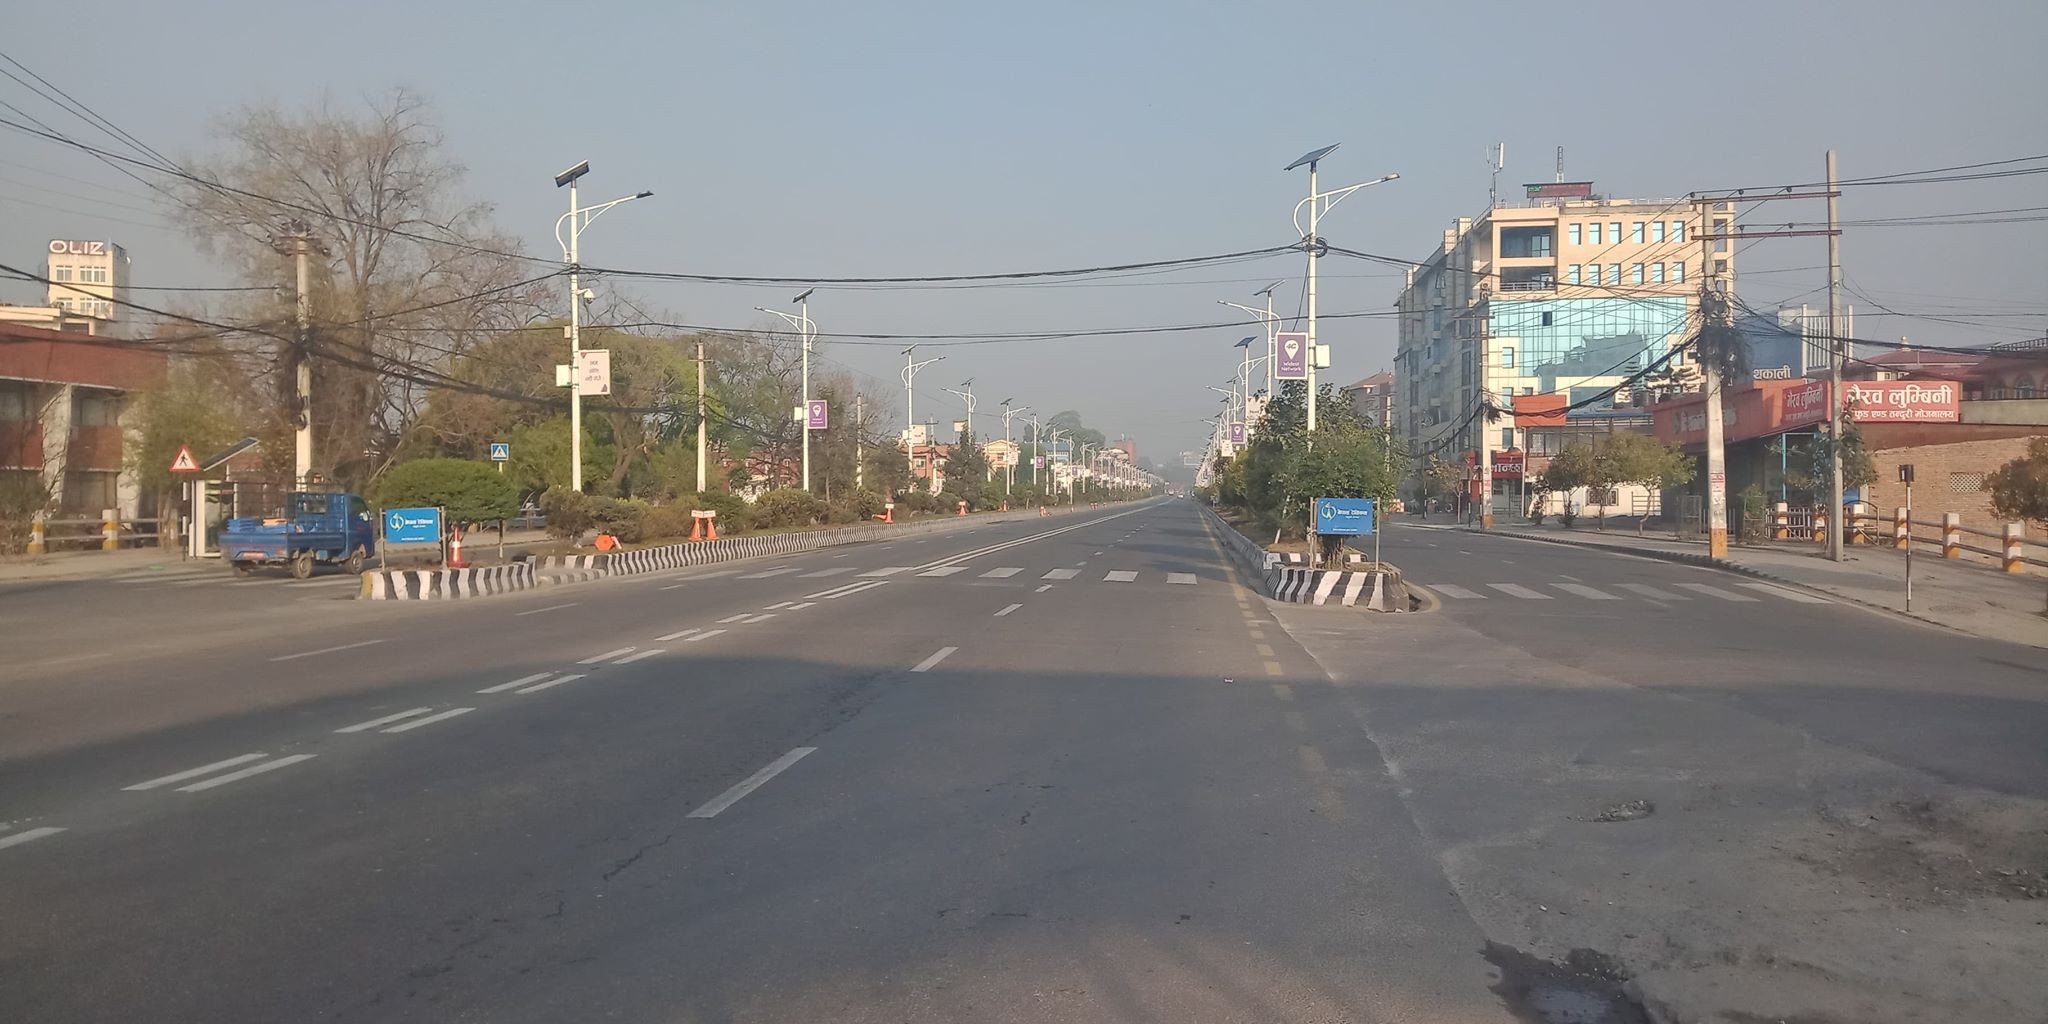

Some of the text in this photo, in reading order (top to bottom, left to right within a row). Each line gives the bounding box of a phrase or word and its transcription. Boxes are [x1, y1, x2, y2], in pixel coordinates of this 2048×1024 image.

[49, 240, 104, 255] OLIZ
[1753, 365, 1791, 379] थकाली
[1888, 384, 1953, 408] लुम्बिनी
